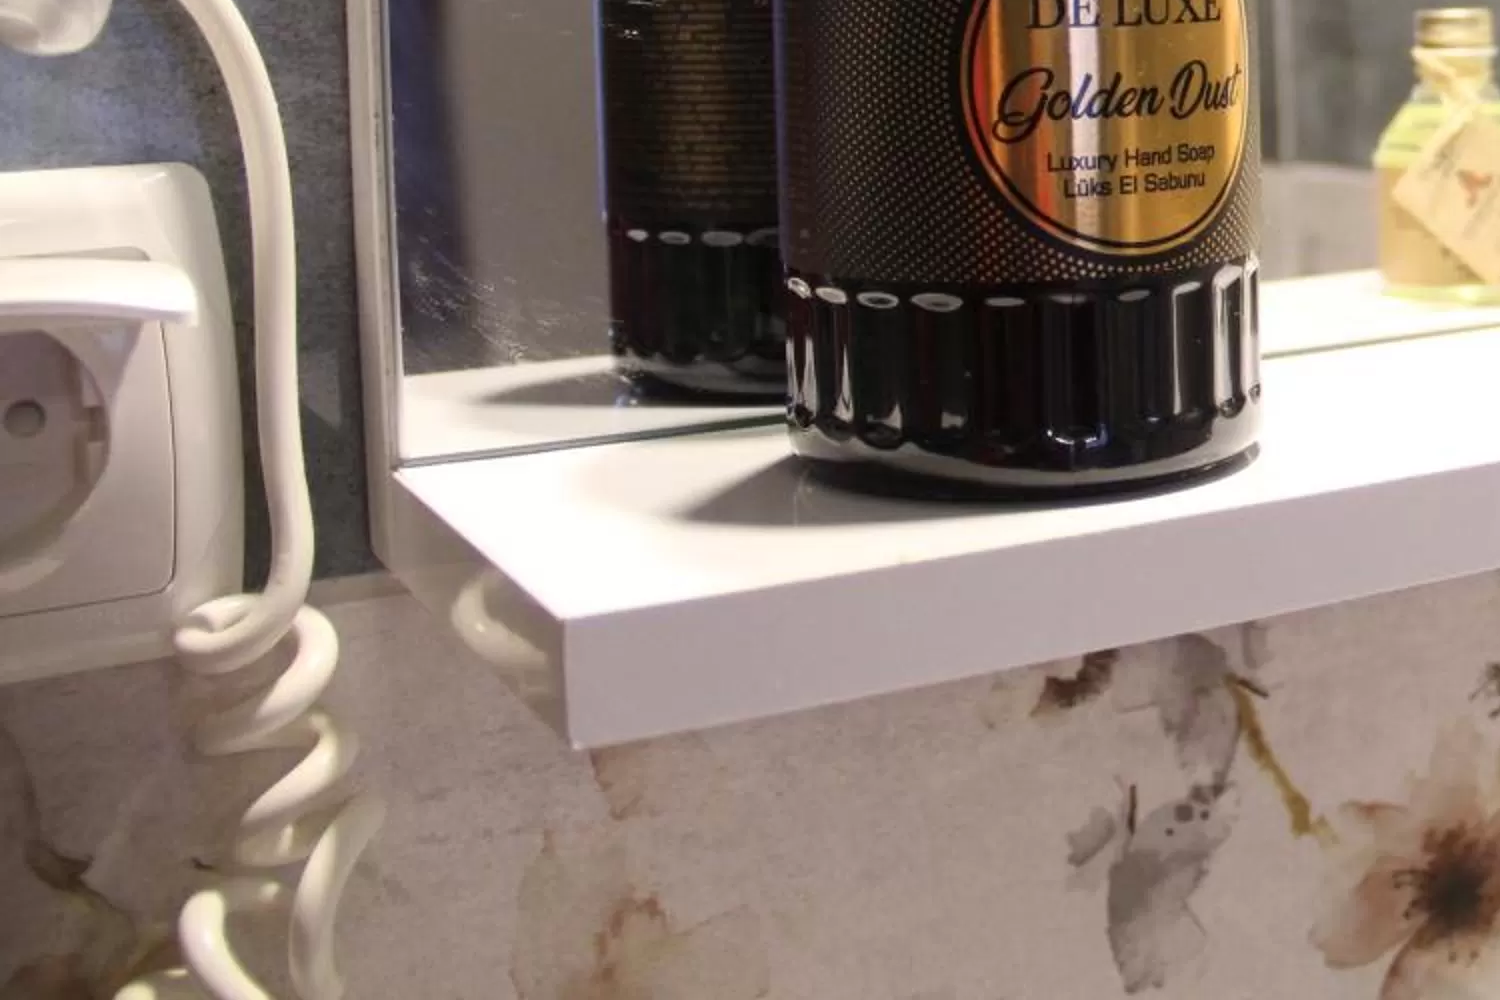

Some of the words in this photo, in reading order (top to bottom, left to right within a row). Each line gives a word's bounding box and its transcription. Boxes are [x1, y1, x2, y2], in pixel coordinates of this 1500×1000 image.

[993, 67, 1164, 143] Golden
[1171, 59, 1243, 119] Dust
[1047, 152, 1118, 174] Luxury
[1124, 146, 1172, 168] Hand
[1177, 143, 1215, 164] Soap
[1063, 177, 1113, 198] Lüks
[1120, 175, 1138, 195] El
[1144, 171, 1206, 193] Sabunu
